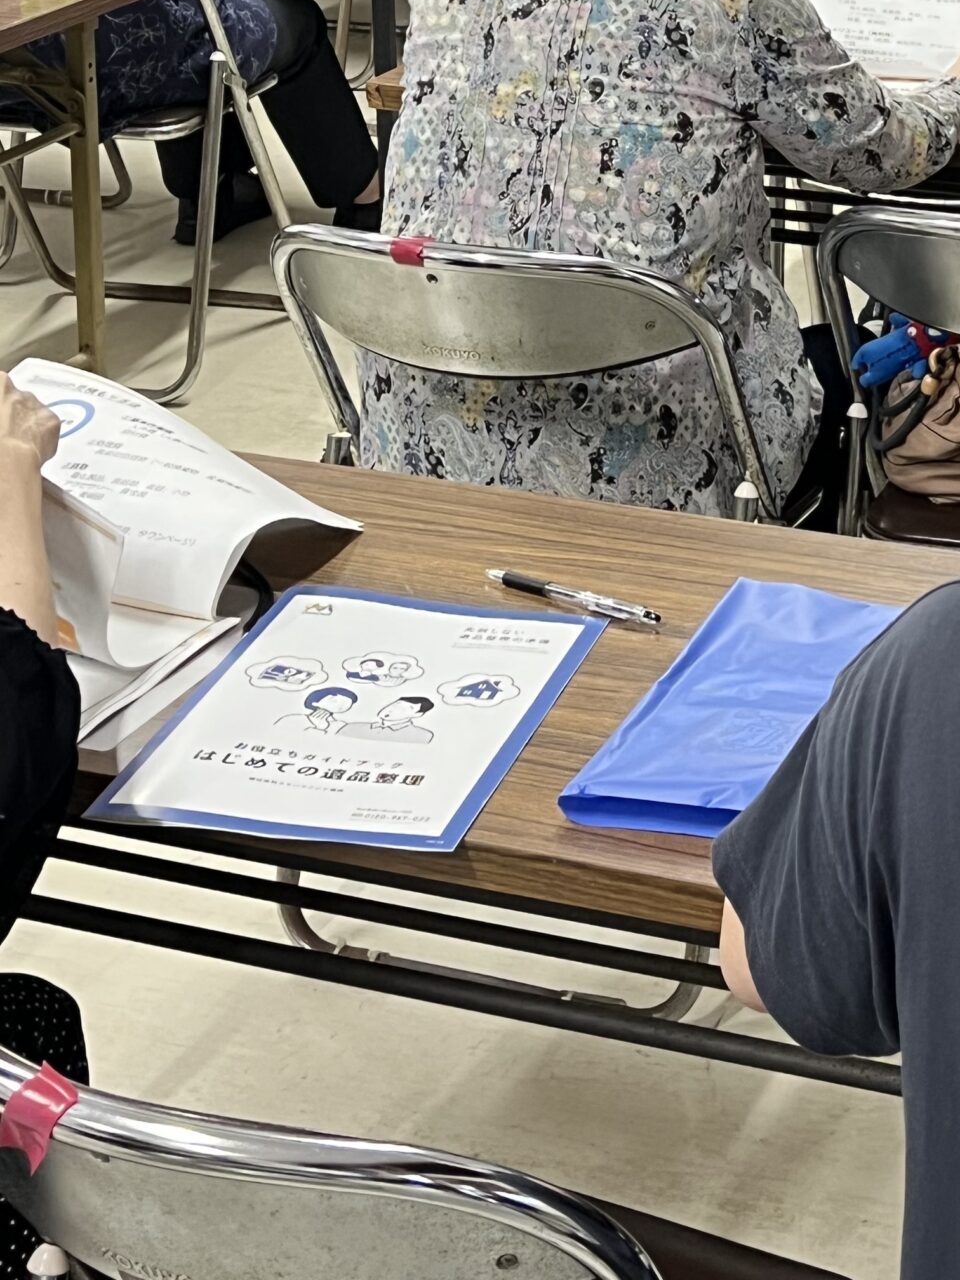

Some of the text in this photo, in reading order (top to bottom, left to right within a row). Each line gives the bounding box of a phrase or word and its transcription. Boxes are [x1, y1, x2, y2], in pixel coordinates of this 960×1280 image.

[421, 340, 481, 360] KOKUYO
[193, 749, 427, 787] はじめての遺品整理
